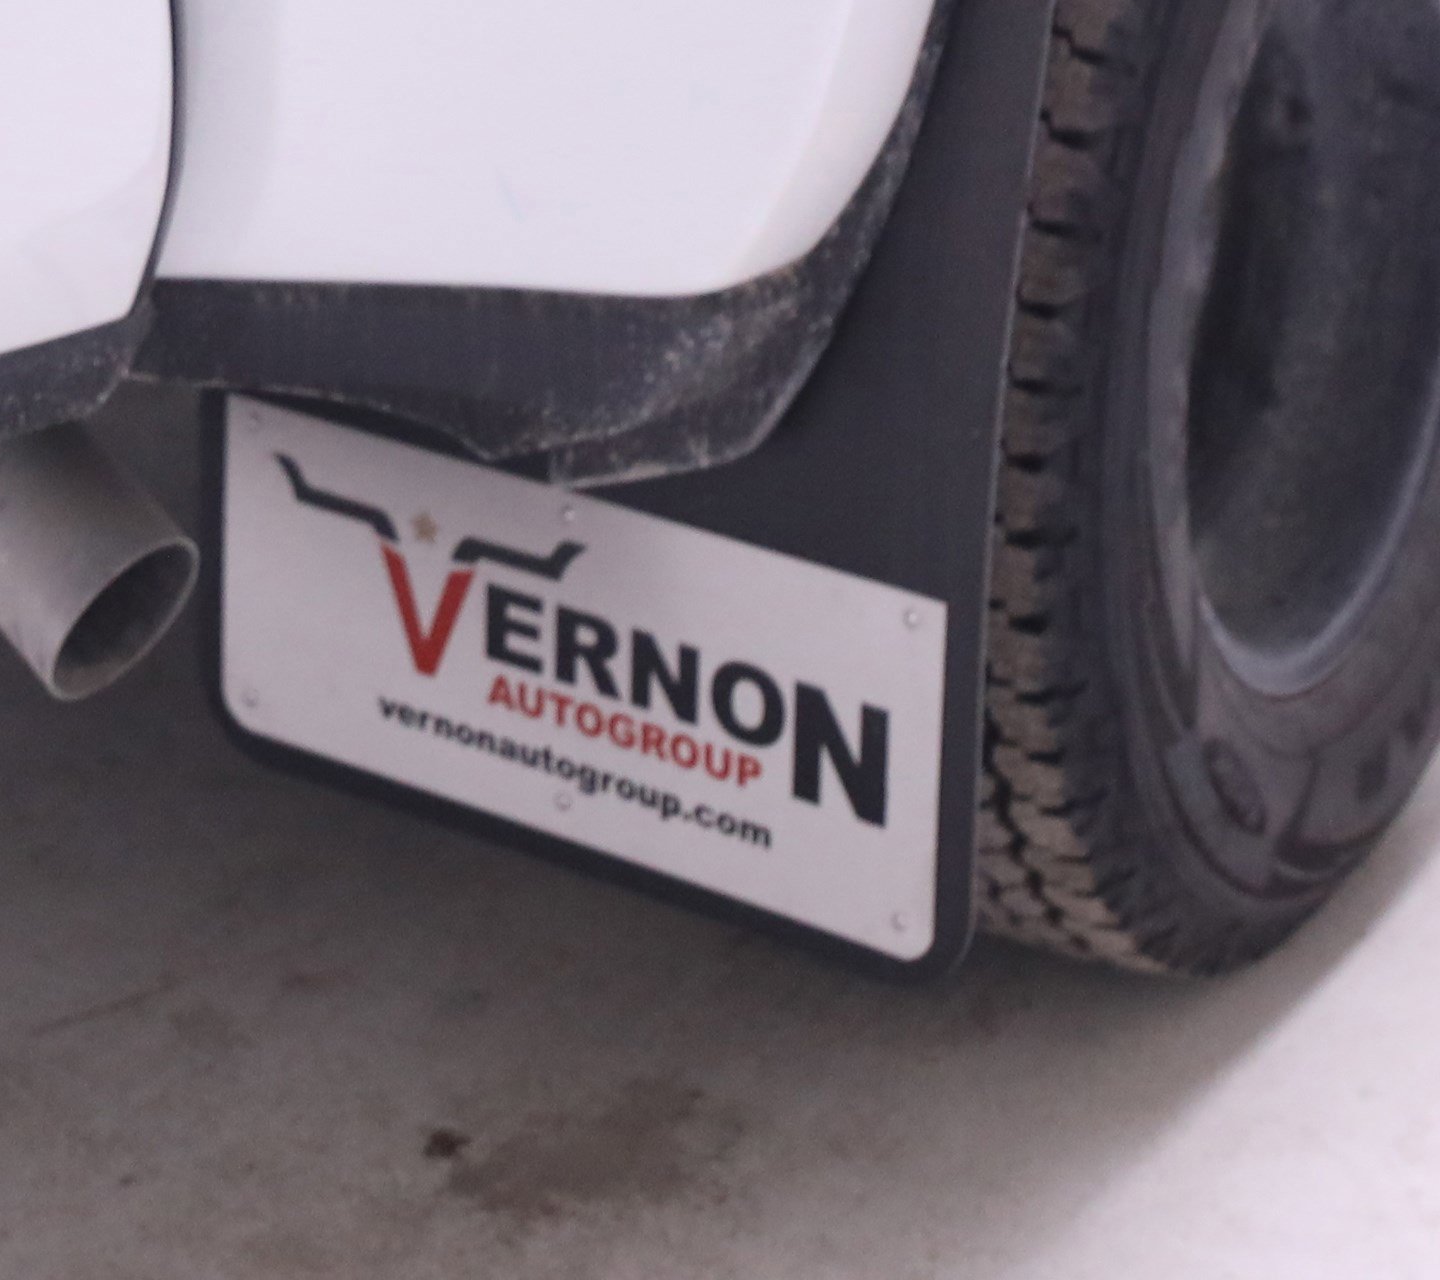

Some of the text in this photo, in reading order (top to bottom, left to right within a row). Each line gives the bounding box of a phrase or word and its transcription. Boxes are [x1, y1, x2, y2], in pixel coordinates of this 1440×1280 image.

[381, 541, 890, 829] VERNON
[487, 675, 764, 790] AUTOGROUP
[377, 695, 775, 850] vernonautogroup.com
